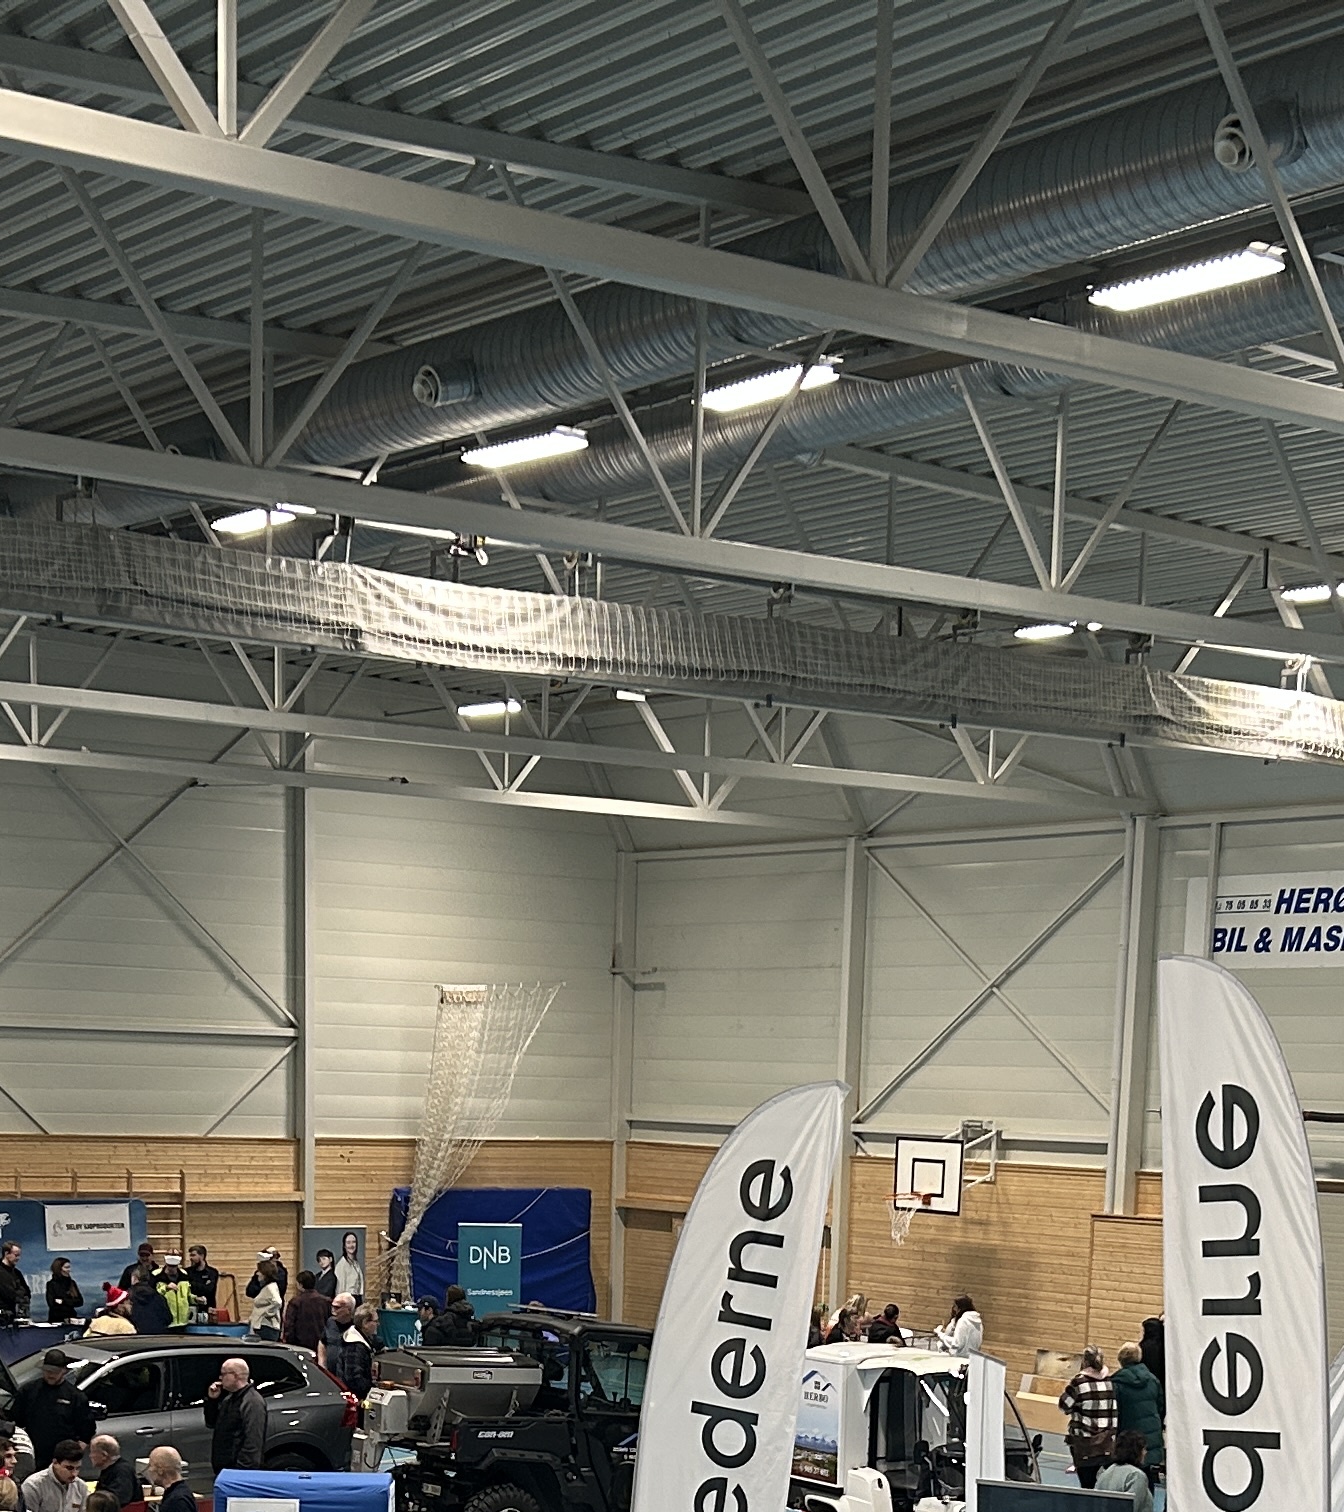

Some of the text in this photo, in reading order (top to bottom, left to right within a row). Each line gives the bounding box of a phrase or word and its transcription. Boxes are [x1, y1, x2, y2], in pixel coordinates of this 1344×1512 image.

[1213, 927, 1248, 953] BIL
[1253, 927, 1272, 953] &
[469, 1239, 511, 1270] DNB
